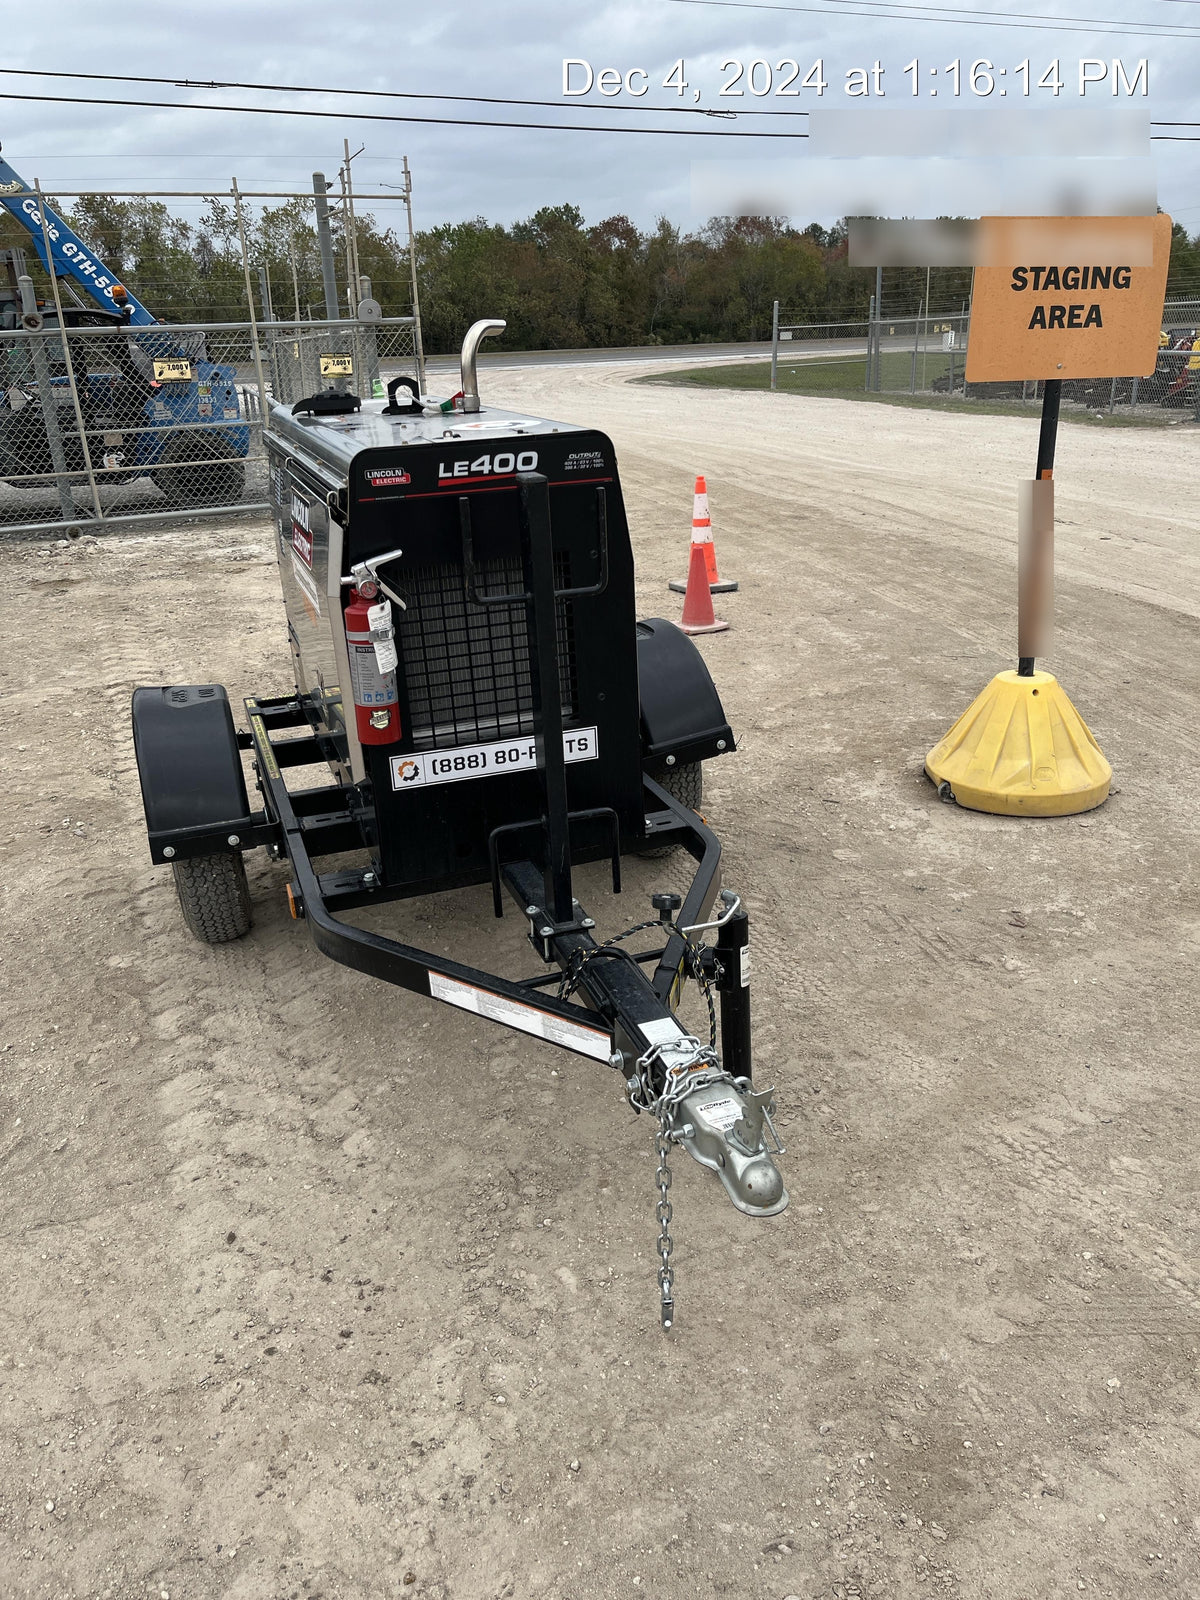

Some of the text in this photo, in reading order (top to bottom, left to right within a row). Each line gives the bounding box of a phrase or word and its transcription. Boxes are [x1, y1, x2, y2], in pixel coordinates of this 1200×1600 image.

[62, 242, 136, 315] GTH-55
[1010, 266, 1132, 292] STAGING
[1028, 304, 1103, 330] AREA
[366, 469, 402, 479] LINCOLN
[438, 451, 539, 478] LE400
[375, 476, 408, 485] ELECTRIC
[432, 752, 487, 775] (888)
